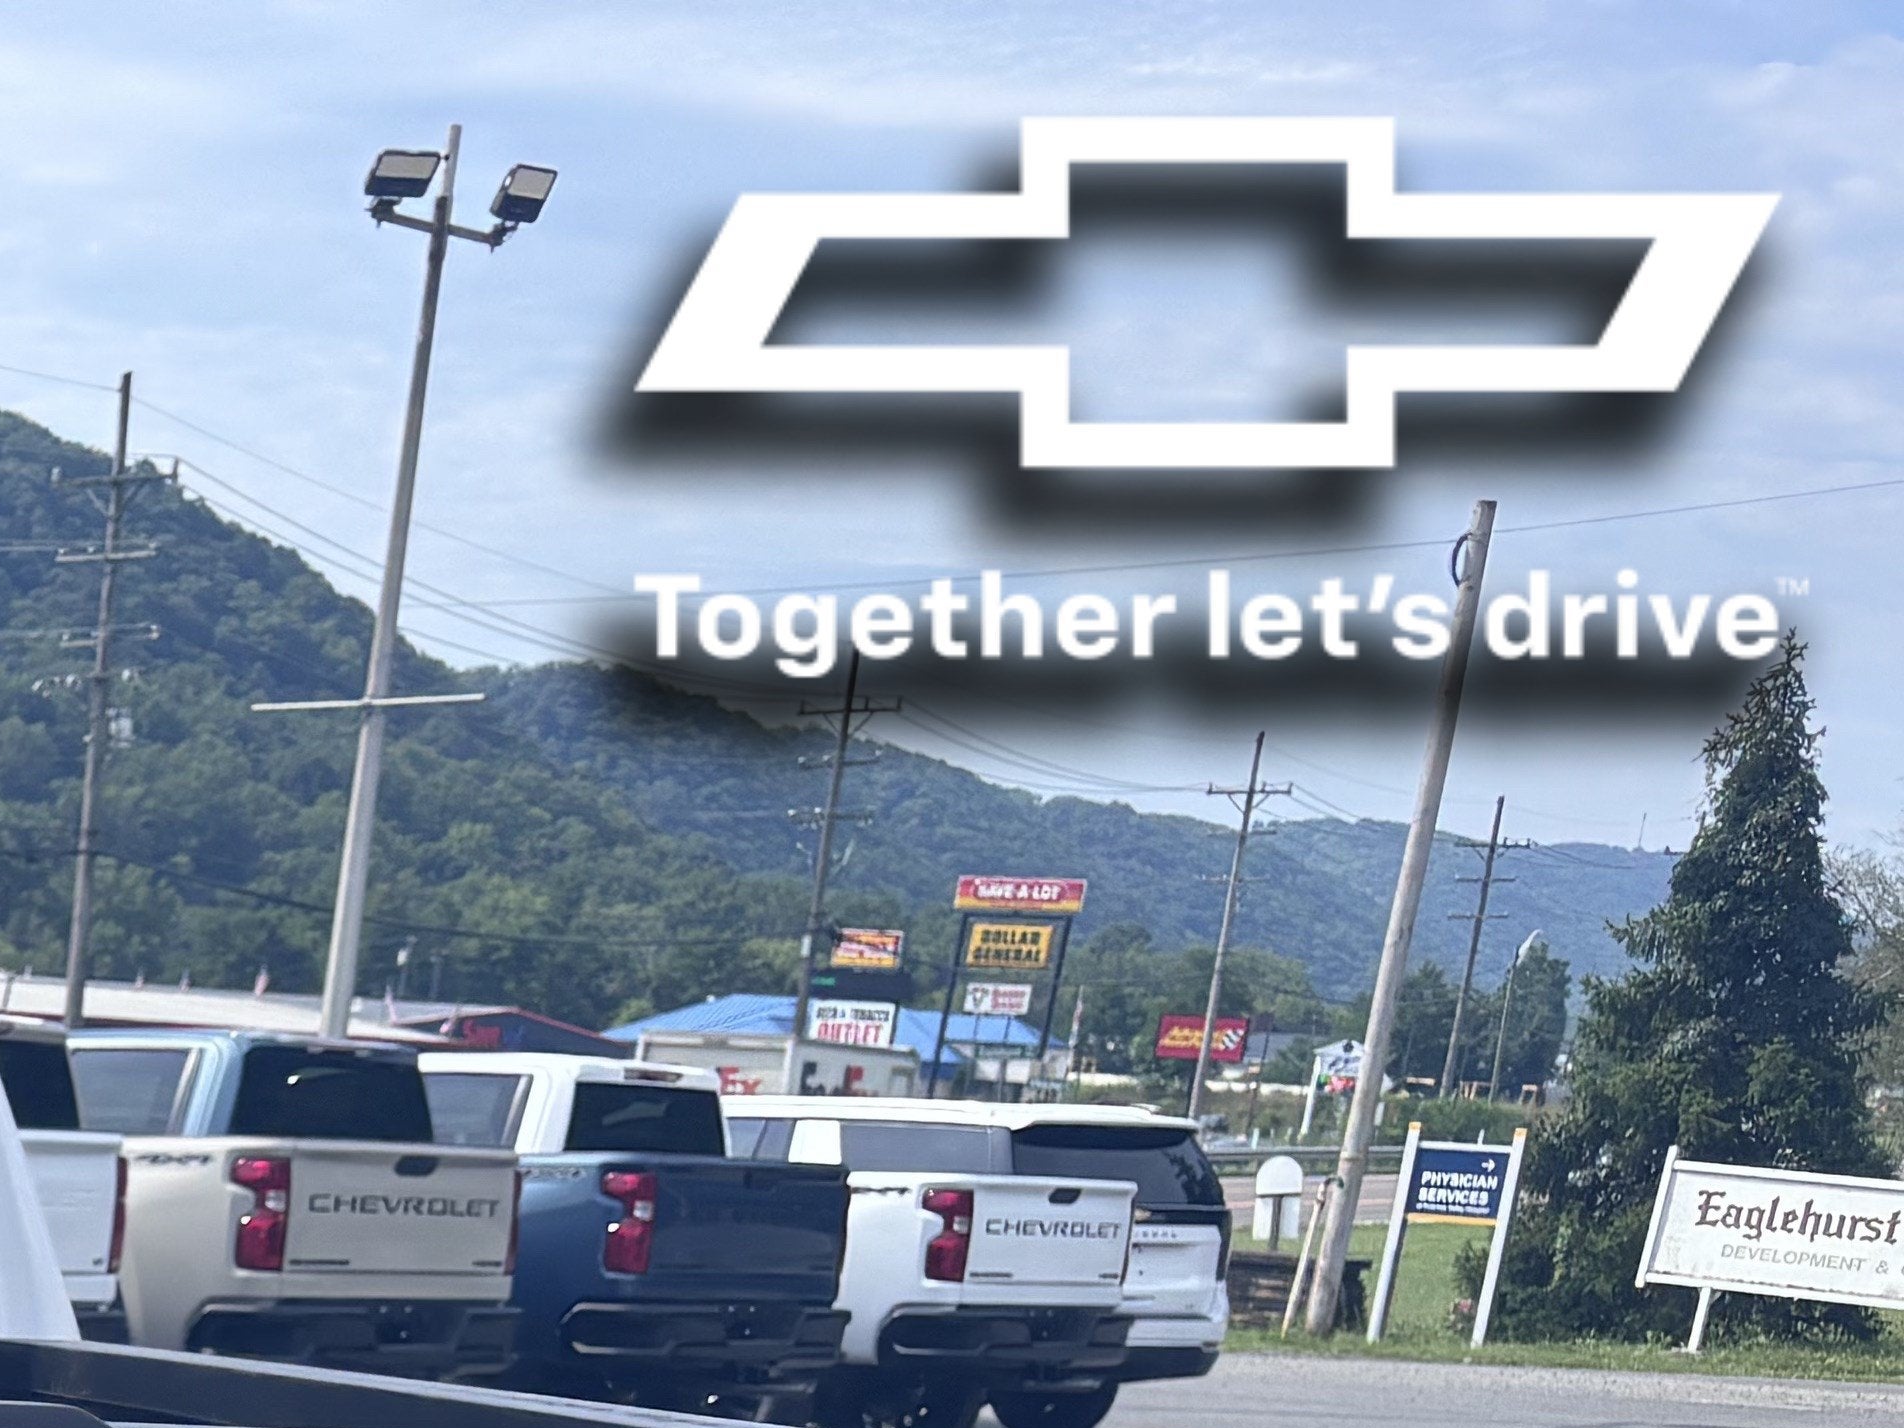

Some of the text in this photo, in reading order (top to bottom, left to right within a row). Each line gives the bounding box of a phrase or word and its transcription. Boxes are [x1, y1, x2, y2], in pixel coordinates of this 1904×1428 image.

[1421, 1170, 1498, 1190] PHYSICIAN
[307, 1192, 501, 1219] CHEVROLET
[1418, 1186, 1489, 1206] SERVICES
[984, 1217, 1121, 1240] CHEVROLET
[1695, 1189, 1902, 1245] Eaglehurst
[1720, 1243, 1890, 1275] DEVELOPMENT &
